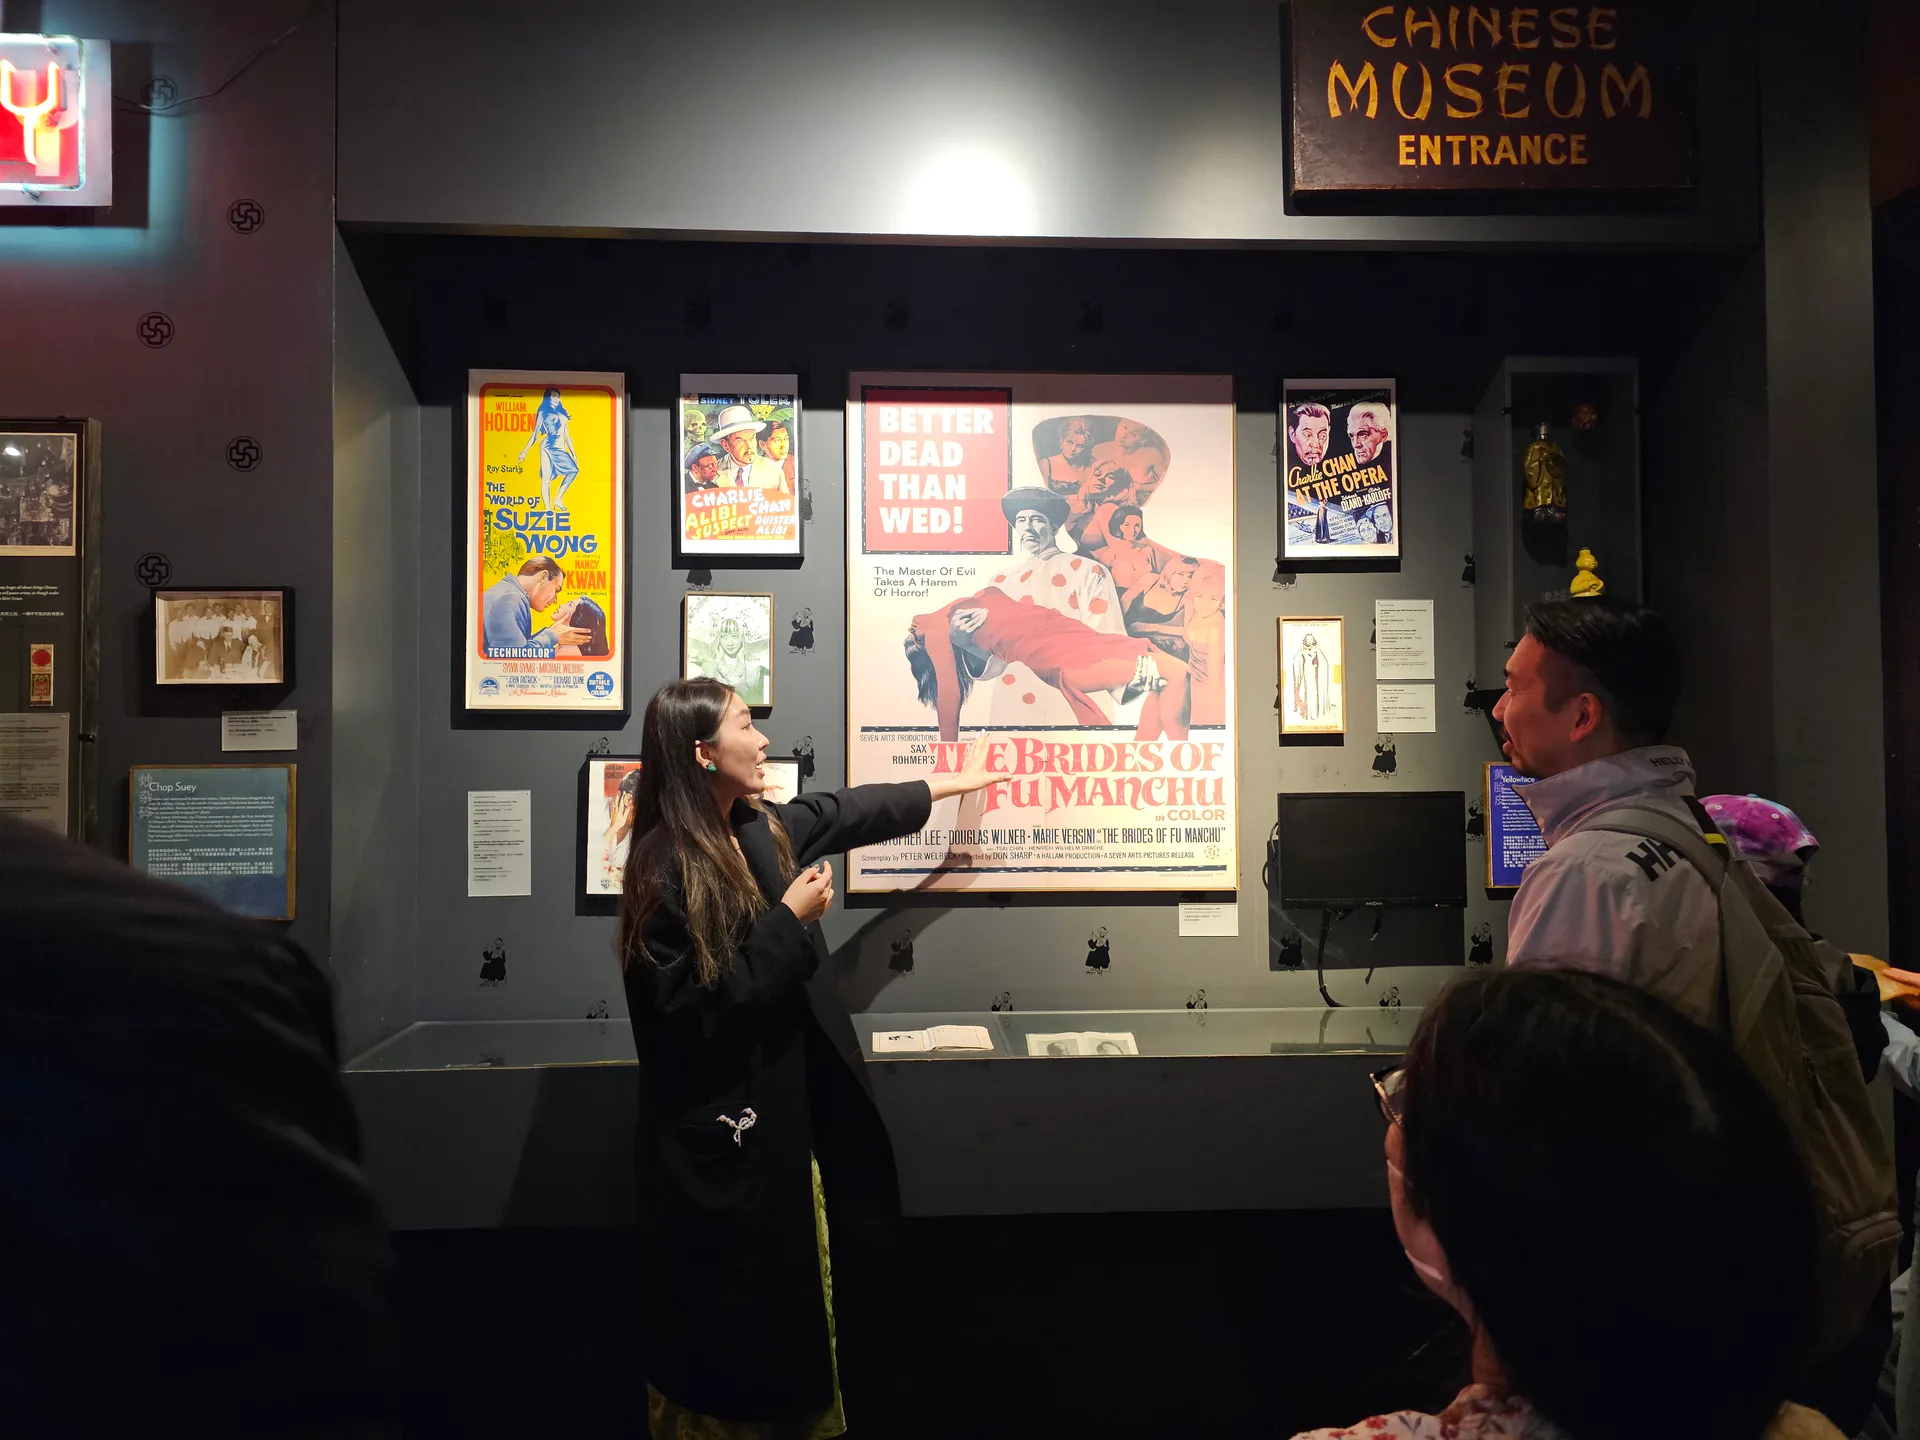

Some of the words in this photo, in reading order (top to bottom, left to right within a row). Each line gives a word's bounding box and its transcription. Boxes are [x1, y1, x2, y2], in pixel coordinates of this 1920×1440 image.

[1361, 6, 1619, 51] CHINESE
[1327, 58, 1653, 121] MUSEUM
[1399, 133, 1588, 166] ENTRANCE
[496, 401, 527, 413] WILLIAM
[701, 396, 734, 405] SIDNEY
[736, 393, 791, 405] TOLER
[485, 412, 537, 433] HOLDEN
[879, 406, 995, 434] BETTER
[879, 440, 964, 467] DEAD
[487, 465, 500, 474] Ray
[1288, 463, 1323, 488] Charlie
[1322, 453, 1357, 476] CHAN
[486, 482, 505, 492] THE
[878, 473, 967, 500] THAN
[1295, 482, 1313, 505] AT
[1313, 474, 1341, 500] THE
[1342, 464, 1388, 492] OPERA
[485, 494, 525, 507] WORLD
[527, 496, 541, 509] OF
[692, 488, 765, 508] CHARLIE
[749, 499, 791, 516] CHAN
[685, 504, 737, 531] ALIBI
[878, 506, 964, 534] WED!
[691, 515, 753, 541] SUSPECT
[756, 526, 788, 535] ALIBI
[516, 533, 598, 558] WONG
[575, 560, 600, 570] NANCY
[874, 567, 894, 576] The
[898, 567, 937, 576] Master
[939, 567, 953, 576] Of
[956, 567, 976, 576] Evil
[566, 571, 607, 590] KWAN
[874, 577, 905, 587] Takes
[908, 578, 917, 587] A
[920, 578, 958, 587] Harem
[874, 588, 887, 597] Of
[891, 588, 929, 597] Horror!
[488, 648, 550, 659] TECHNICOLOR
[860, 734, 879, 742] SEVEN
[880, 734, 896, 742] ARTS
[897, 734, 938, 742] PRODUCTIONS
[910, 744, 927, 753] SAX
[1008, 737, 1165, 776] BRIDES
[1170, 742, 1226, 772] OF
[892, 755, 936, 765] ROHMER'S
[148, 781, 174, 793] Chop
[175, 781, 197, 793] Suey
[980, 778, 1043, 816] FU
[1045, 775, 1227, 815] MANCHU
[1167, 809, 1226, 822] COLOR
[925, 830, 941, 846] LEE
[949, 829, 989, 846] DOUGLAS
[991, 829, 1026, 845] WILNER
[1033, 828, 1060, 844] MARIE
[1061, 828, 1096, 844] VERSINI
[1122, 828, 1153, 844] BRIDES
[1156, 828, 1167, 844] OF
[1170, 828, 1182, 844] FU
[861, 854, 891, 863] Screenplay
[892, 854, 900, 862] by
[901, 852, 923, 861] PETER
[924, 852, 958, 861] WELBECK
[992, 851, 1008, 860] DON
[1010, 851, 1033, 860] SHARP
[1171, 851, 1195, 859] RELEASE
